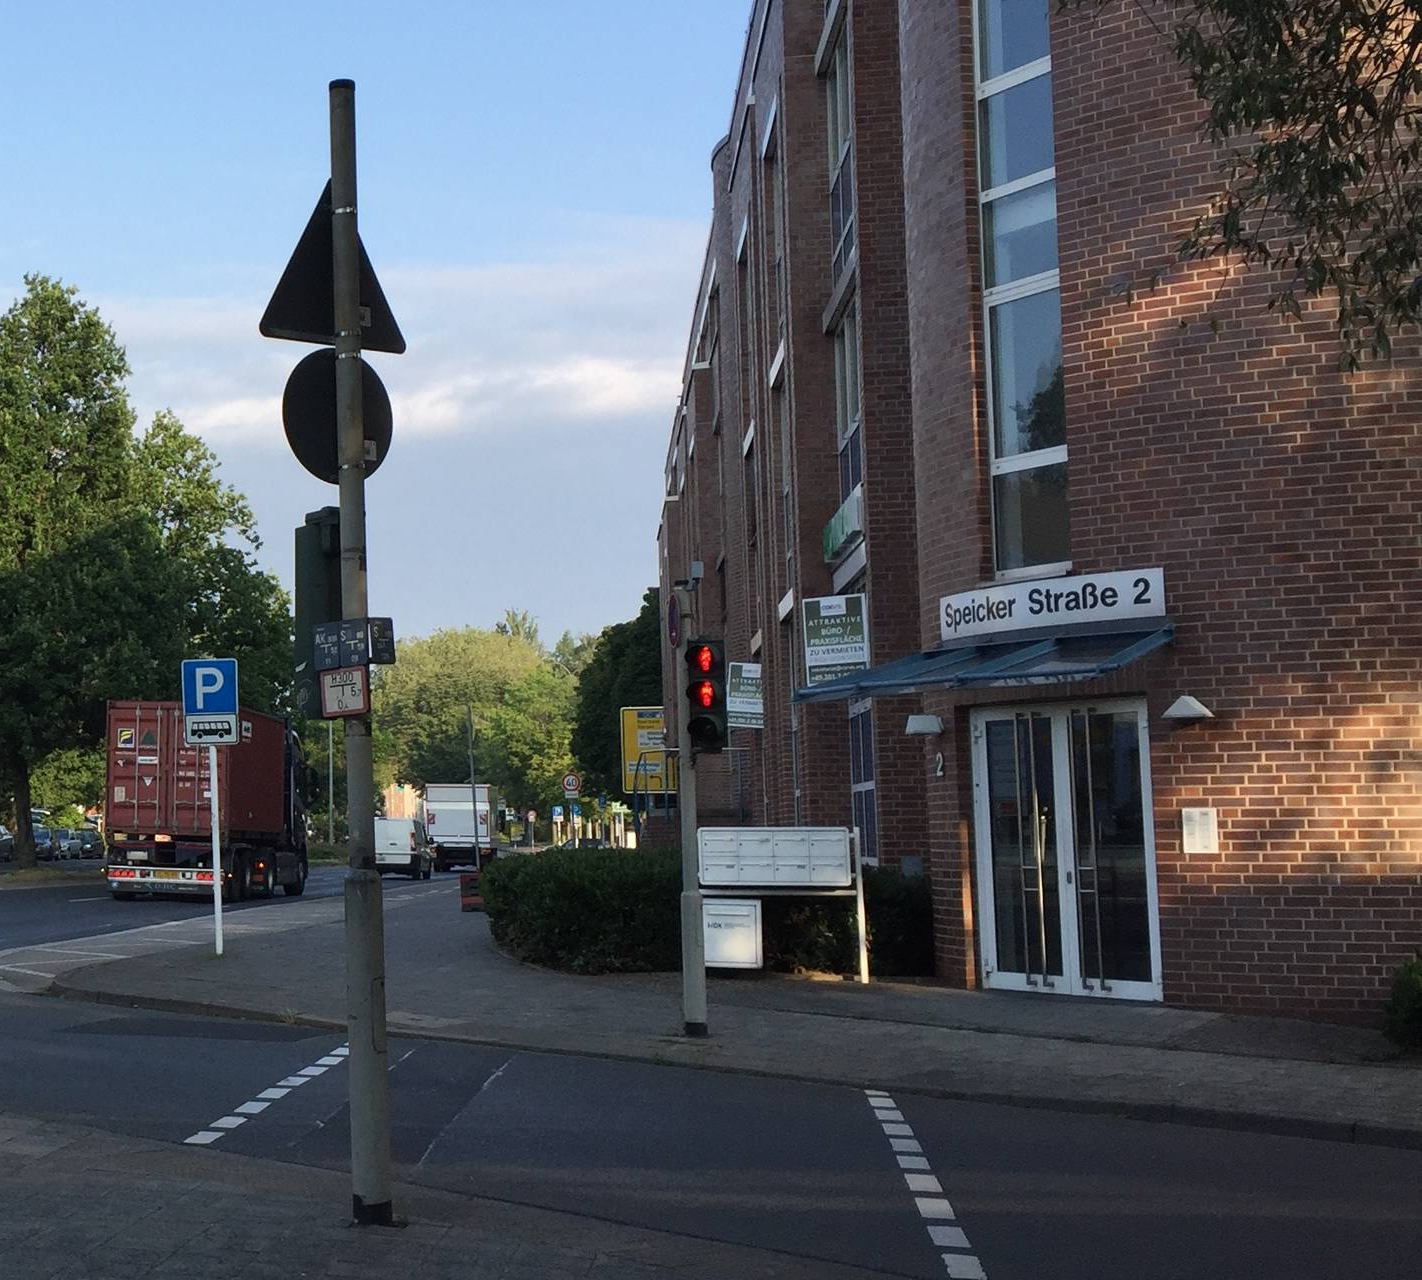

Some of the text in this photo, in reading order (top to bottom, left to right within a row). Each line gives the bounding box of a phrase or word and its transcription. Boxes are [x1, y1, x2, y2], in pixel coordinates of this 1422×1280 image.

[944, 577, 1152, 633] Speicker Straße 2
[808, 615, 861, 627] ATTRAKTIVE
[195, 667, 224, 709] P
[936, 751, 944, 777] 2
[566, 778, 577, 787] 40
